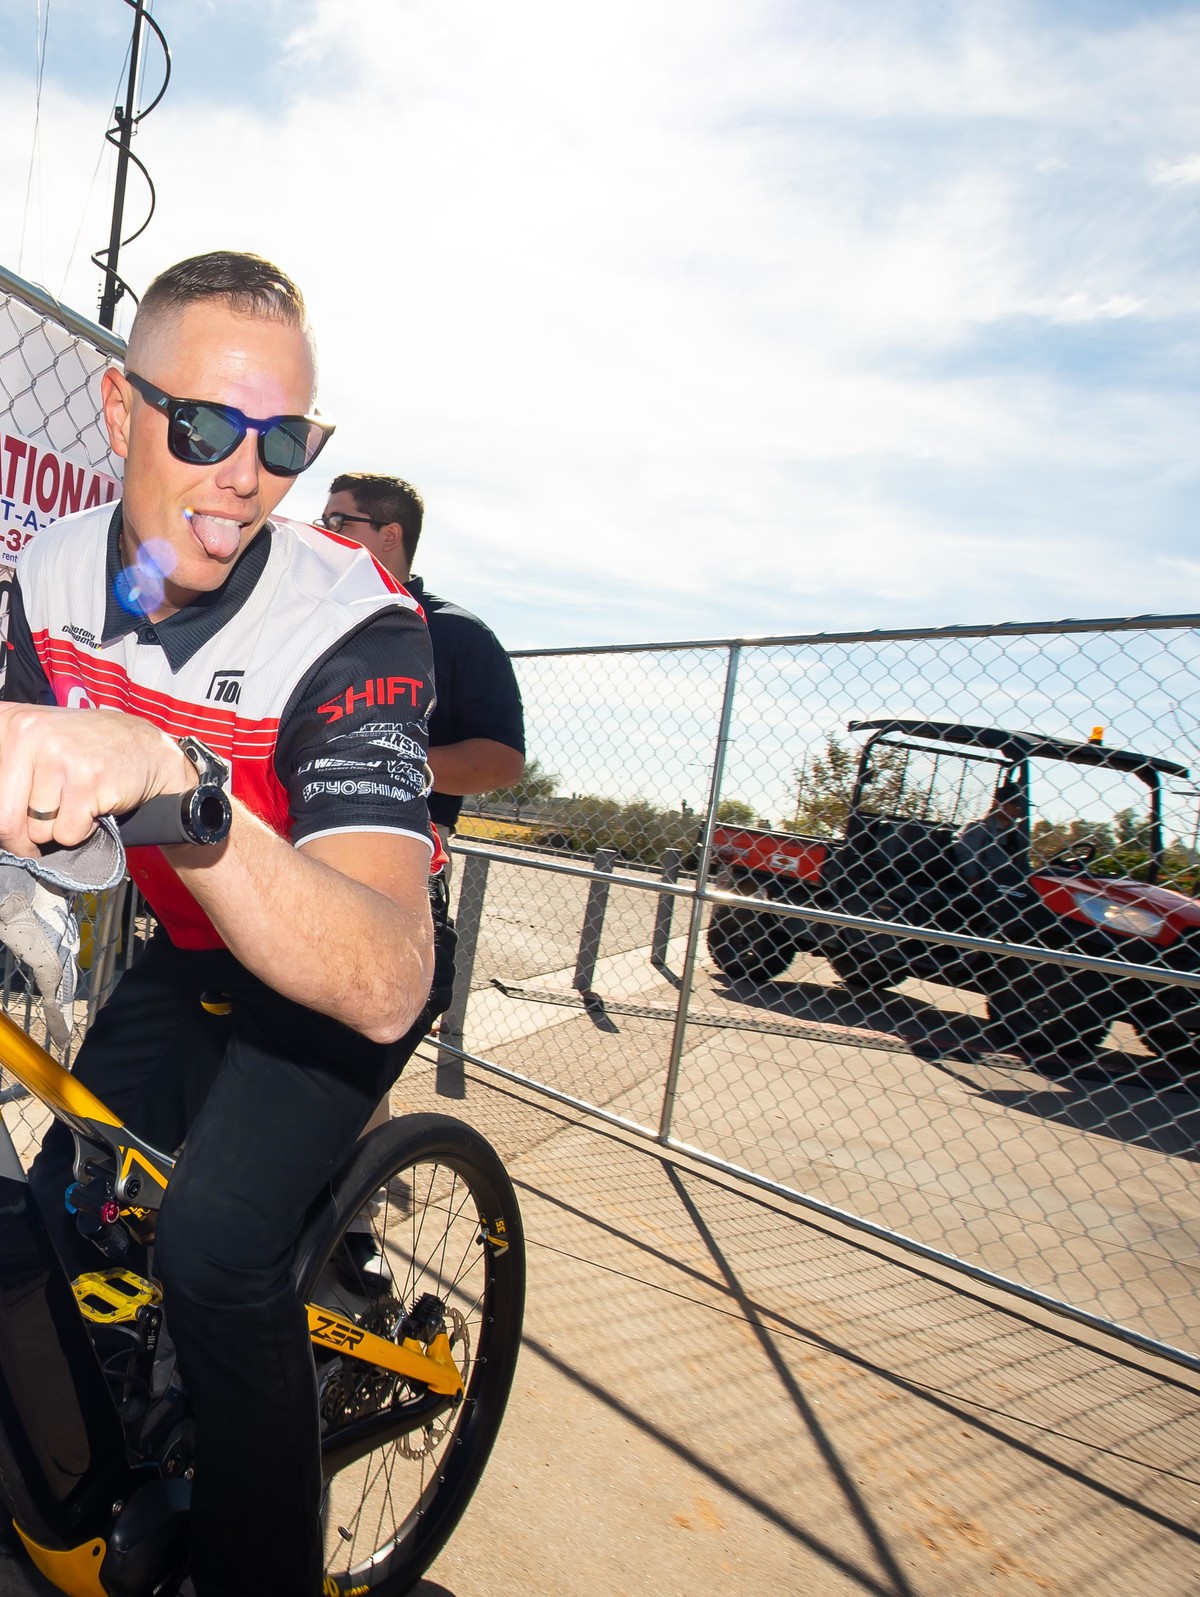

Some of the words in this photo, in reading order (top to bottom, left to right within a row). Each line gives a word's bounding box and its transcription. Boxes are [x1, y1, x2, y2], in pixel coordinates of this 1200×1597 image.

[69, 622, 96, 641] actory
[317, 676, 424, 724] SHIFT
[386, 760, 424, 787] VORTE
[325, 780, 416, 802] YOSHIM
